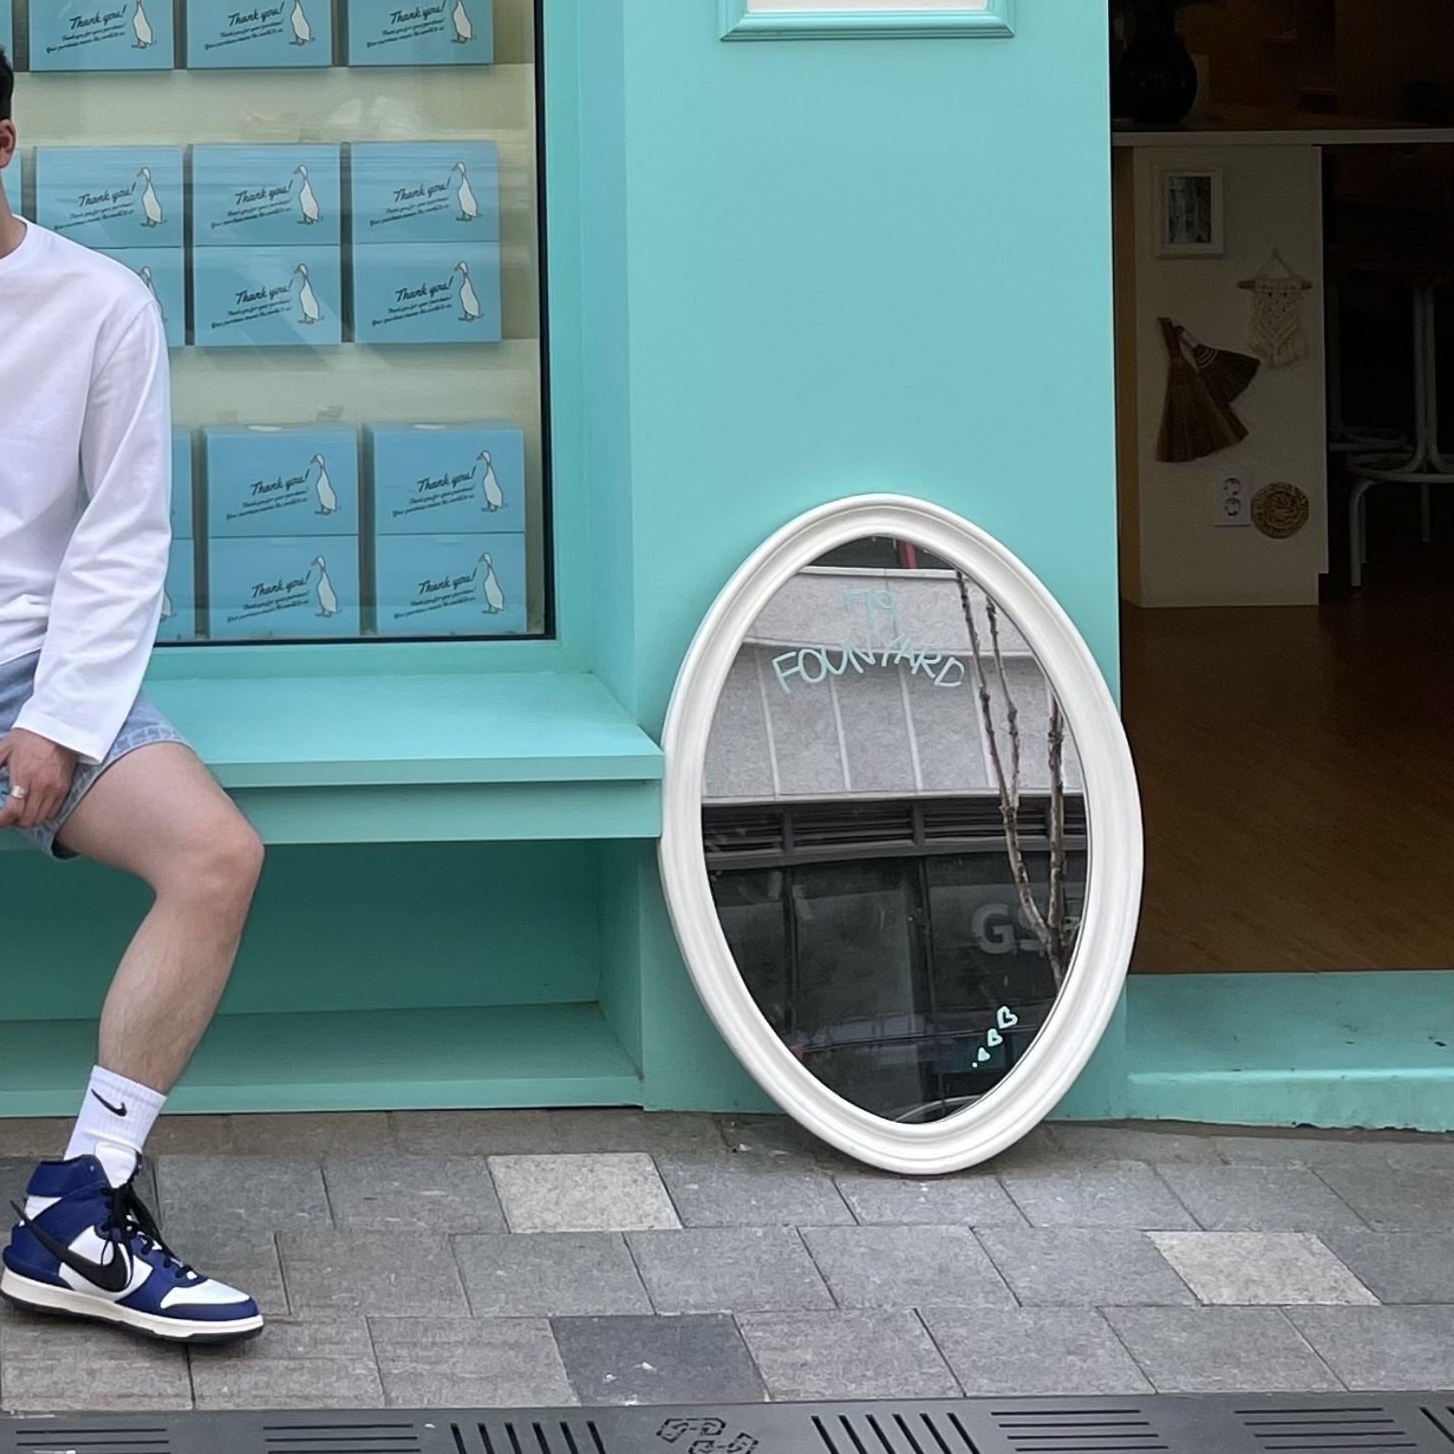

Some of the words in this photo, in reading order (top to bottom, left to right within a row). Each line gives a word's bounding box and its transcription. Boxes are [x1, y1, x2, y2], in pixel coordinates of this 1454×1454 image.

[69, 12, 101, 30] Thank
[227, 8, 259, 26] Thank
[389, 6, 421, 24] Thank
[78, 189, 110, 207] Thank
[235, 186, 267, 204] Thank
[393, 184, 425, 202] Thank
[235, 286, 267, 304] Thank
[395, 284, 427, 302] Thank
[250, 476, 283, 495] Thank
[416, 474, 449, 492] Thank
[251, 578, 284, 597] Thank
[417, 576, 450, 594] Thank
[771, 632, 966, 695] FOUNYARD
